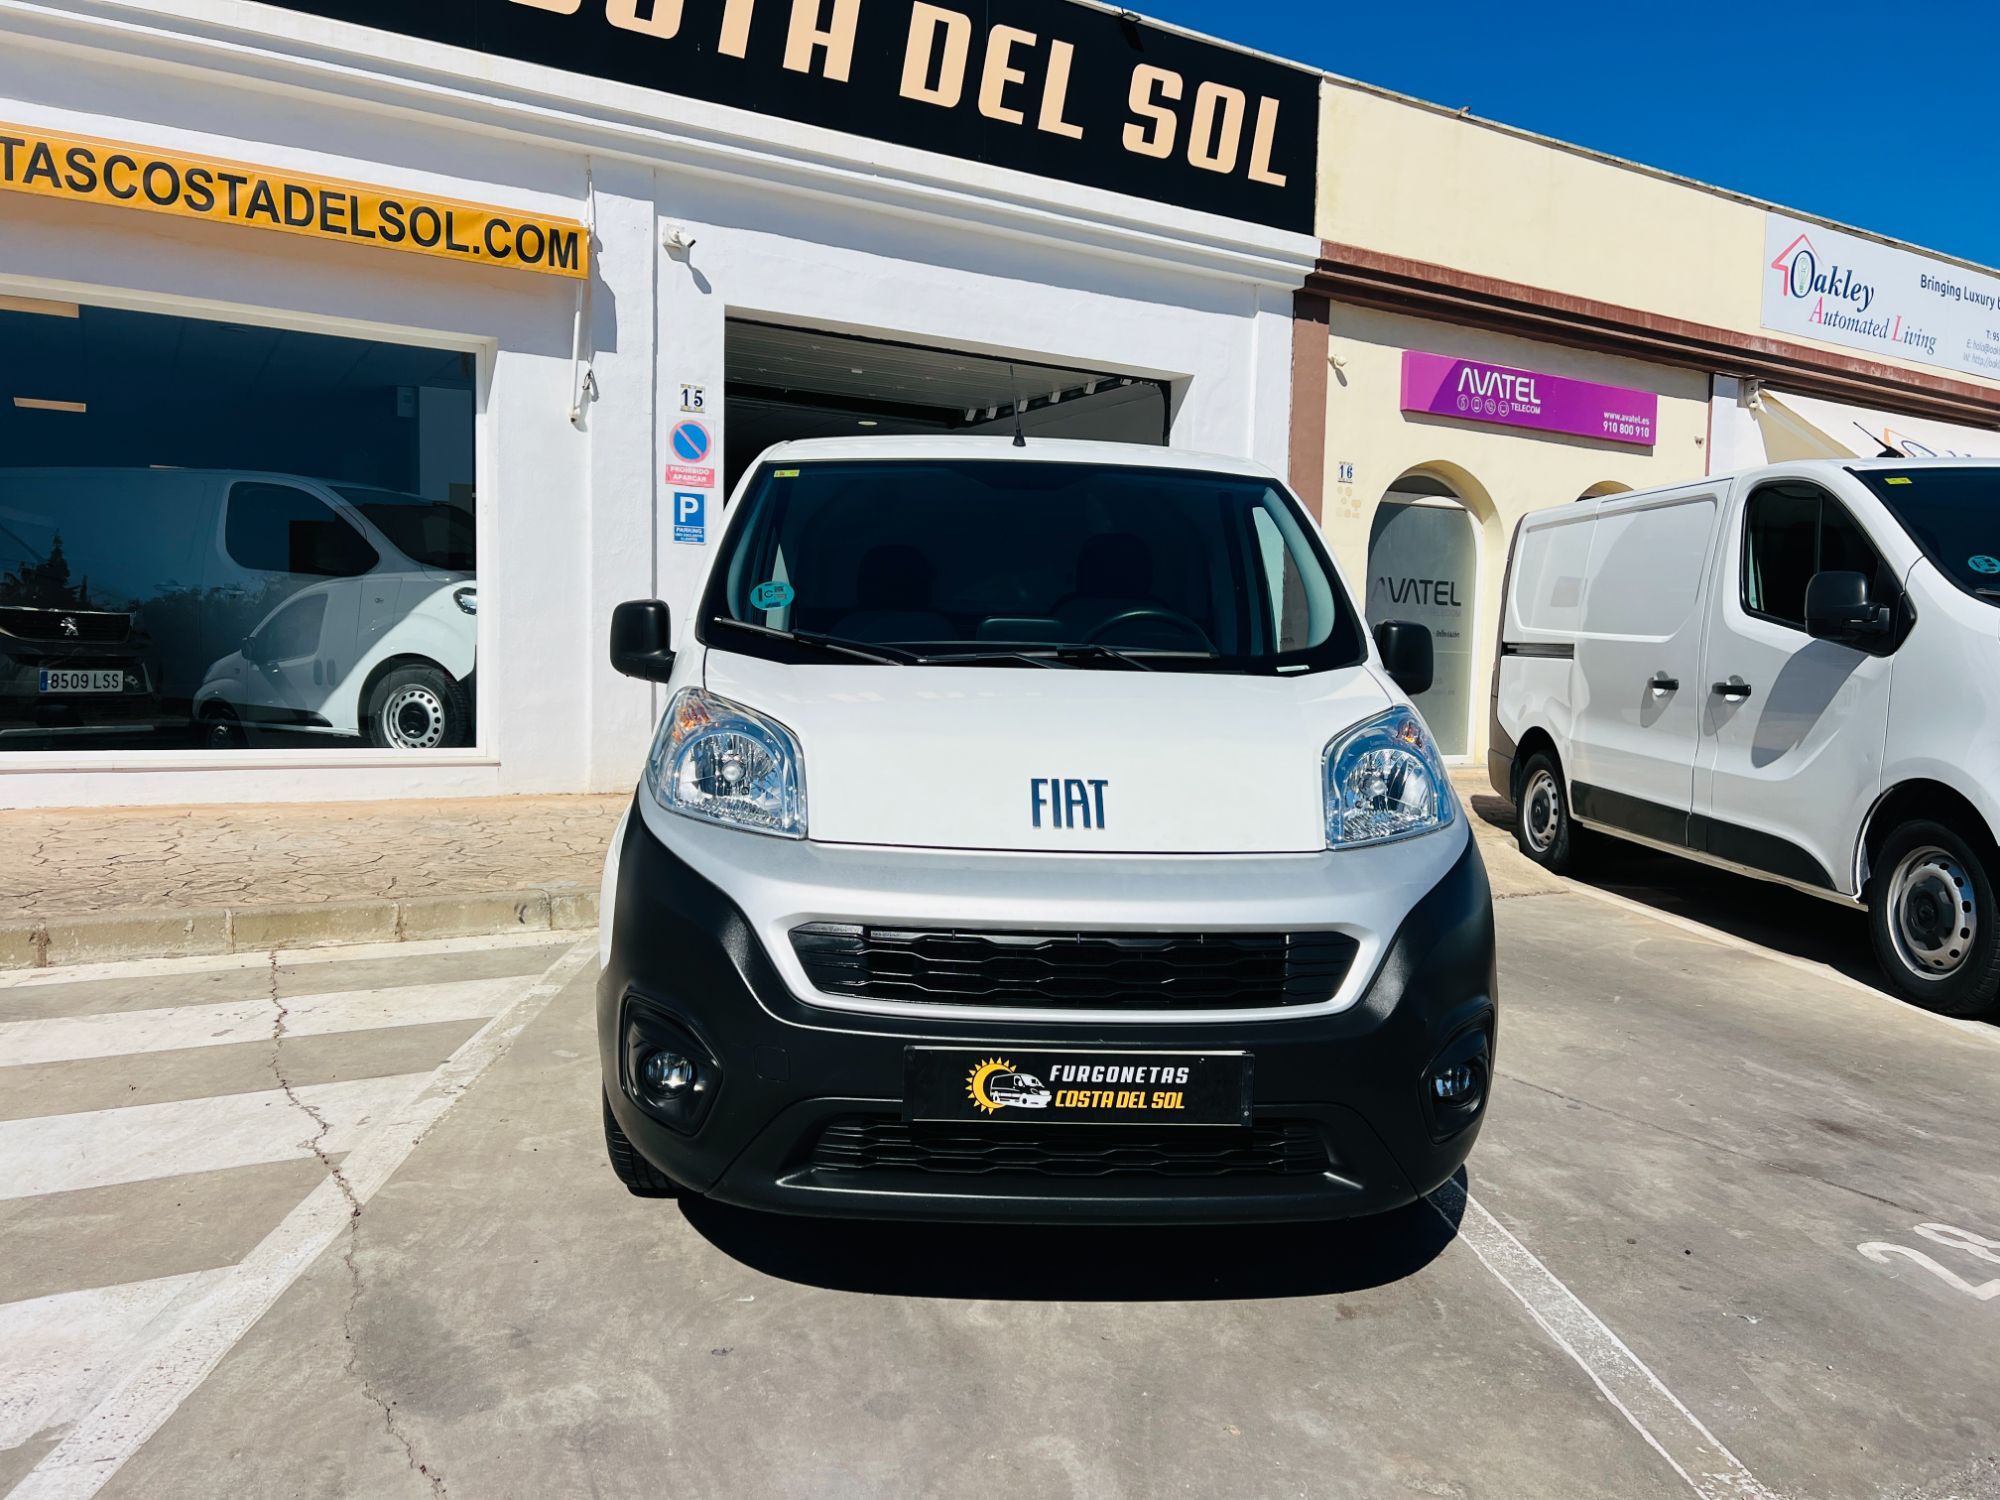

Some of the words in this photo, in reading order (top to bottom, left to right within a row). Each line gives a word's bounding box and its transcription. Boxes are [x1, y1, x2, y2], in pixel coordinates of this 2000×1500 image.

[899, 0, 1083, 140] DEL
[1122, 63, 1287, 188] SOL
[0, 136, 579, 271] TASCOSTADELSOL.COM
[1790, 249, 1874, 313] Oakley
[1920, 273, 1961, 301] Bringing
[1963, 285, 1995, 310] Luxury
[1809, 296, 1890, 339] Automated
[1891, 315, 1937, 355] Living
[1458, 367, 1541, 404] AVATEL
[681, 388, 703, 407] 15
[1510, 402, 1541, 415] TELECOM
[1603, 411, 1650, 425] www.avatel.es
[1603, 421, 1618, 433] 910
[1619, 423, 1634, 436] 800
[1636, 426, 1650, 438] 910
[670, 465, 710, 476] PROHIBIDO
[1340, 464, 1353, 479] 16
[680, 496, 699, 523] P
[1371, 577, 1461, 606] AVATEL
[50, 672, 89, 689] 8509
[93, 673, 119, 689] LSS
[1030, 778, 1109, 829] FIAT
[1049, 1064, 1189, 1084] FURGONETAS
[1055, 1090, 1113, 1109] COSTA
[1115, 1091, 1148, 1109] DEL
[1154, 1091, 1185, 1109] SOL
